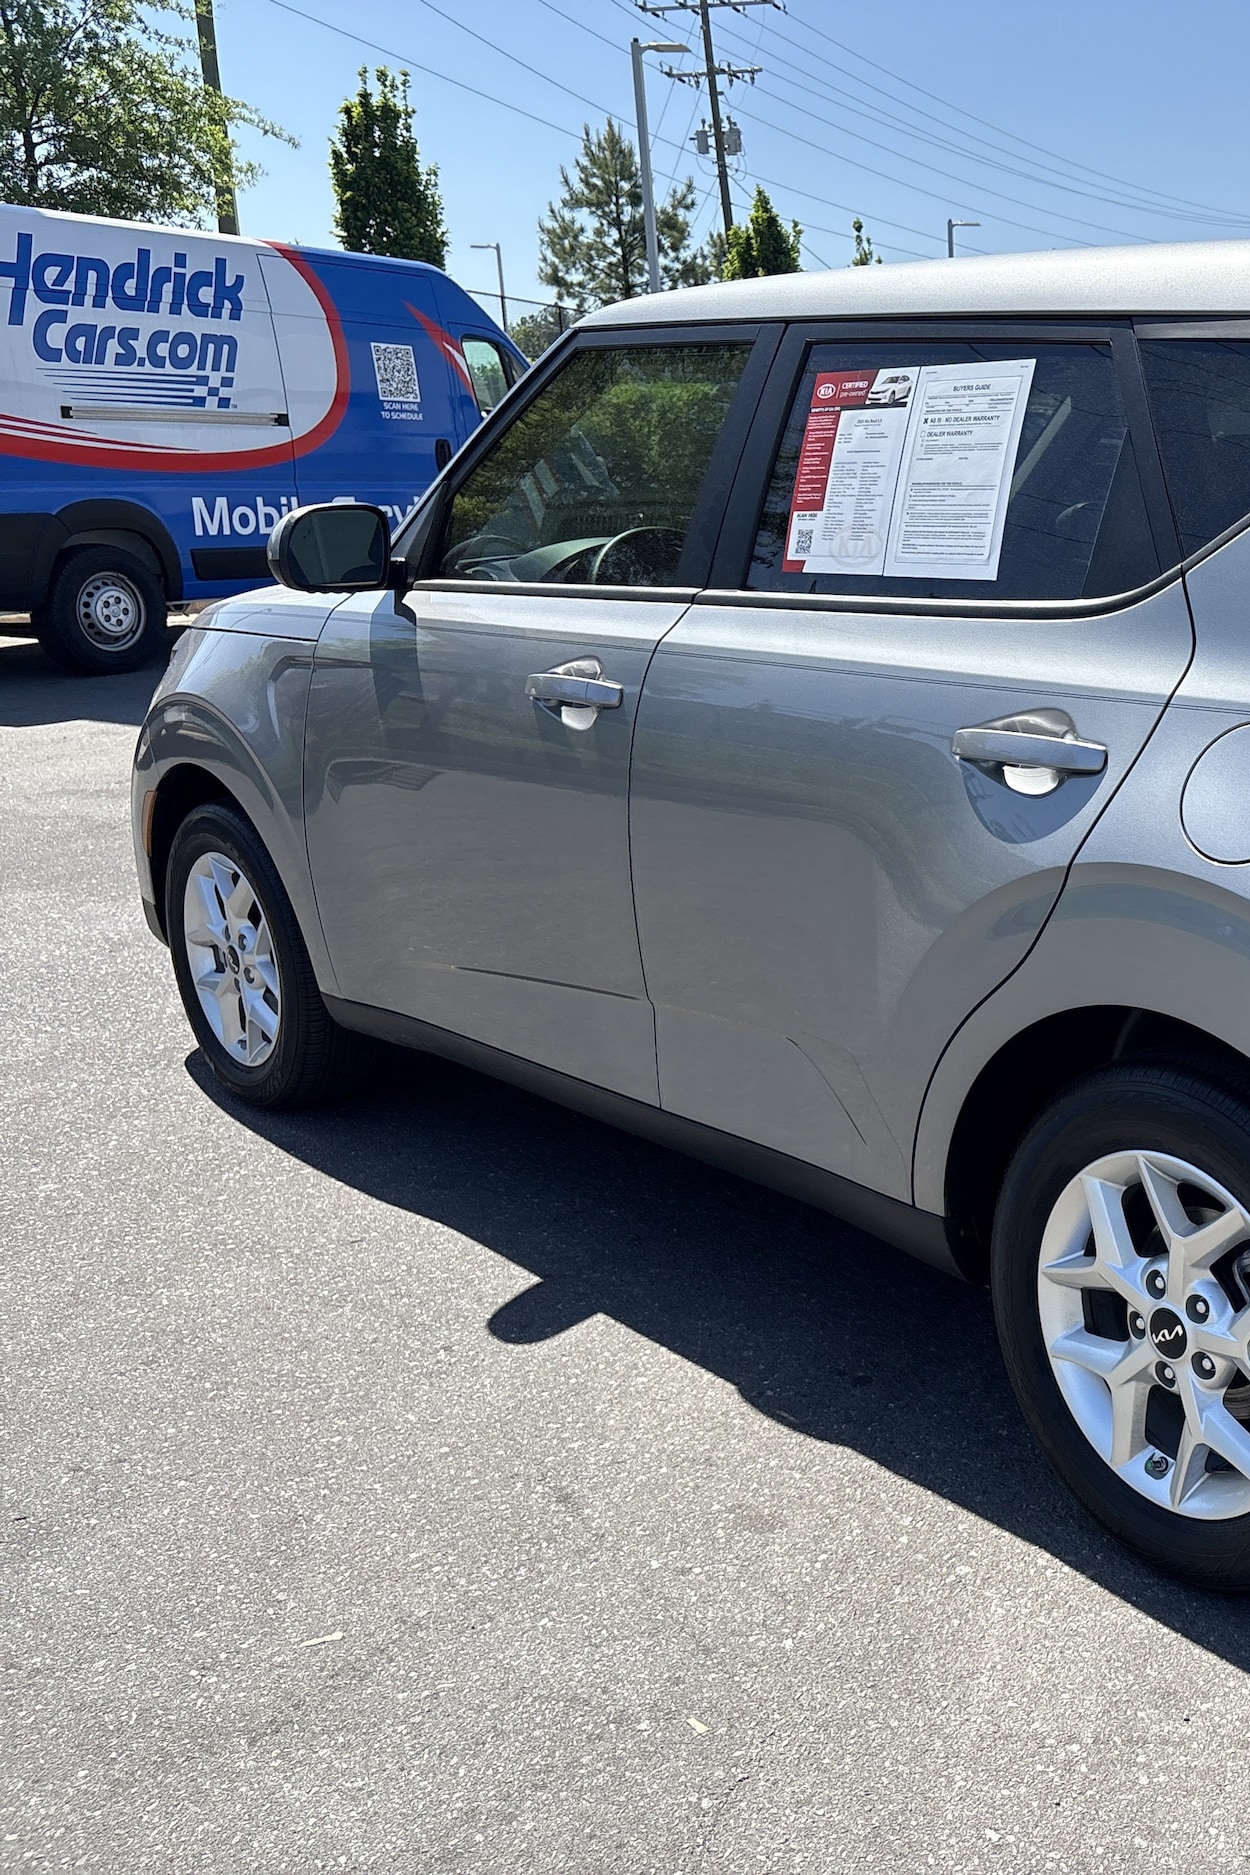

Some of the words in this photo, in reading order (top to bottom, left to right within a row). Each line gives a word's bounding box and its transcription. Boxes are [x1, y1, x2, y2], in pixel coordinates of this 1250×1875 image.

[0, 232, 245, 325] Hendrick
[33, 308, 238, 372] Cars.com
[842, 381, 868, 389] CERTIFIED
[381, 411, 390, 419] TO
[391, 412, 424, 420] SCHEDULE
[383, 402, 401, 410] SCAN
[402, 403, 419, 411] HERE
[191, 496, 298, 536] Mobi
[1152, 1324, 1183, 1344] KIA
